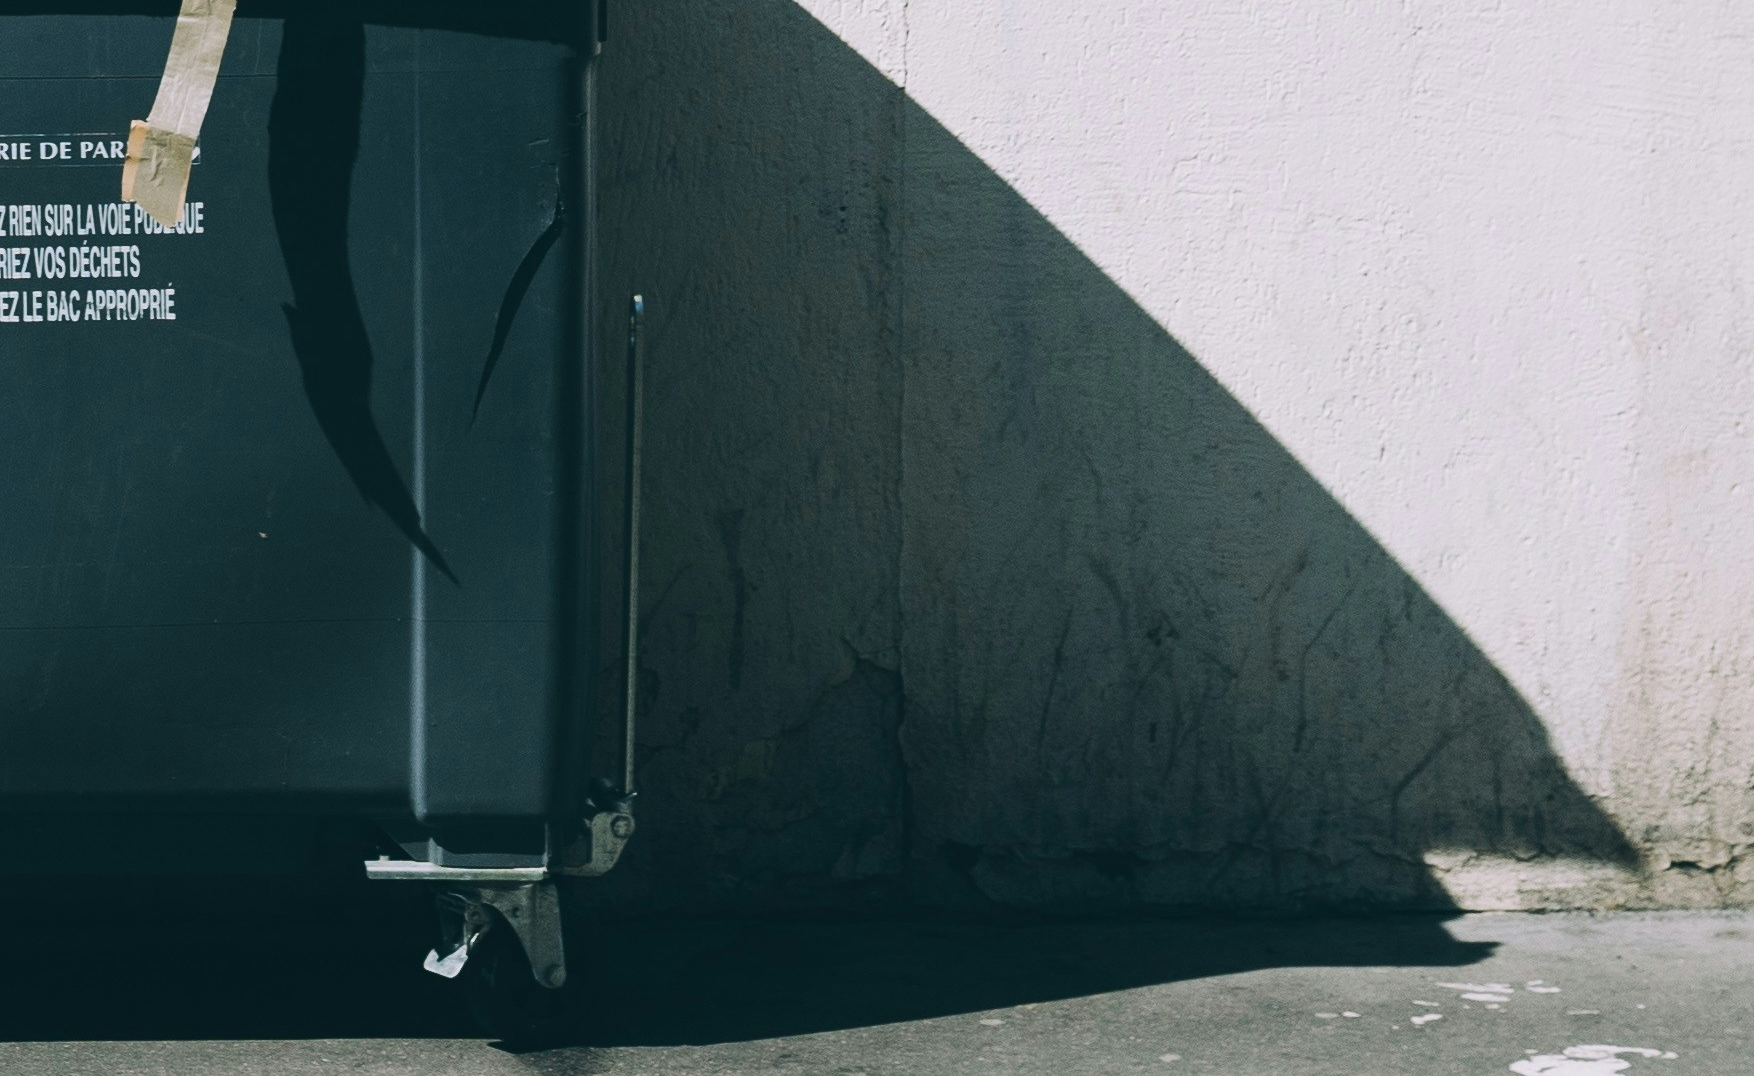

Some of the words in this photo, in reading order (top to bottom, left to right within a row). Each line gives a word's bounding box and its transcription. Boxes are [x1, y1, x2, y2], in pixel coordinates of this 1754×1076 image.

[39, 141, 72, 160] DE
[79, 140, 129, 159] PAR
[8, 204, 42, 237] RIEN
[44, 203, 74, 237] SUR
[76, 203, 96, 236] LA
[97, 203, 131, 236] VOIE
[33, 245, 67, 280] VOS
[68, 239, 141, 279] DÉCHETS
[22, 290, 44, 323] LE
[46, 289, 81, 322] BAC
[83, 282, 177, 321] APPROPRIÉ
